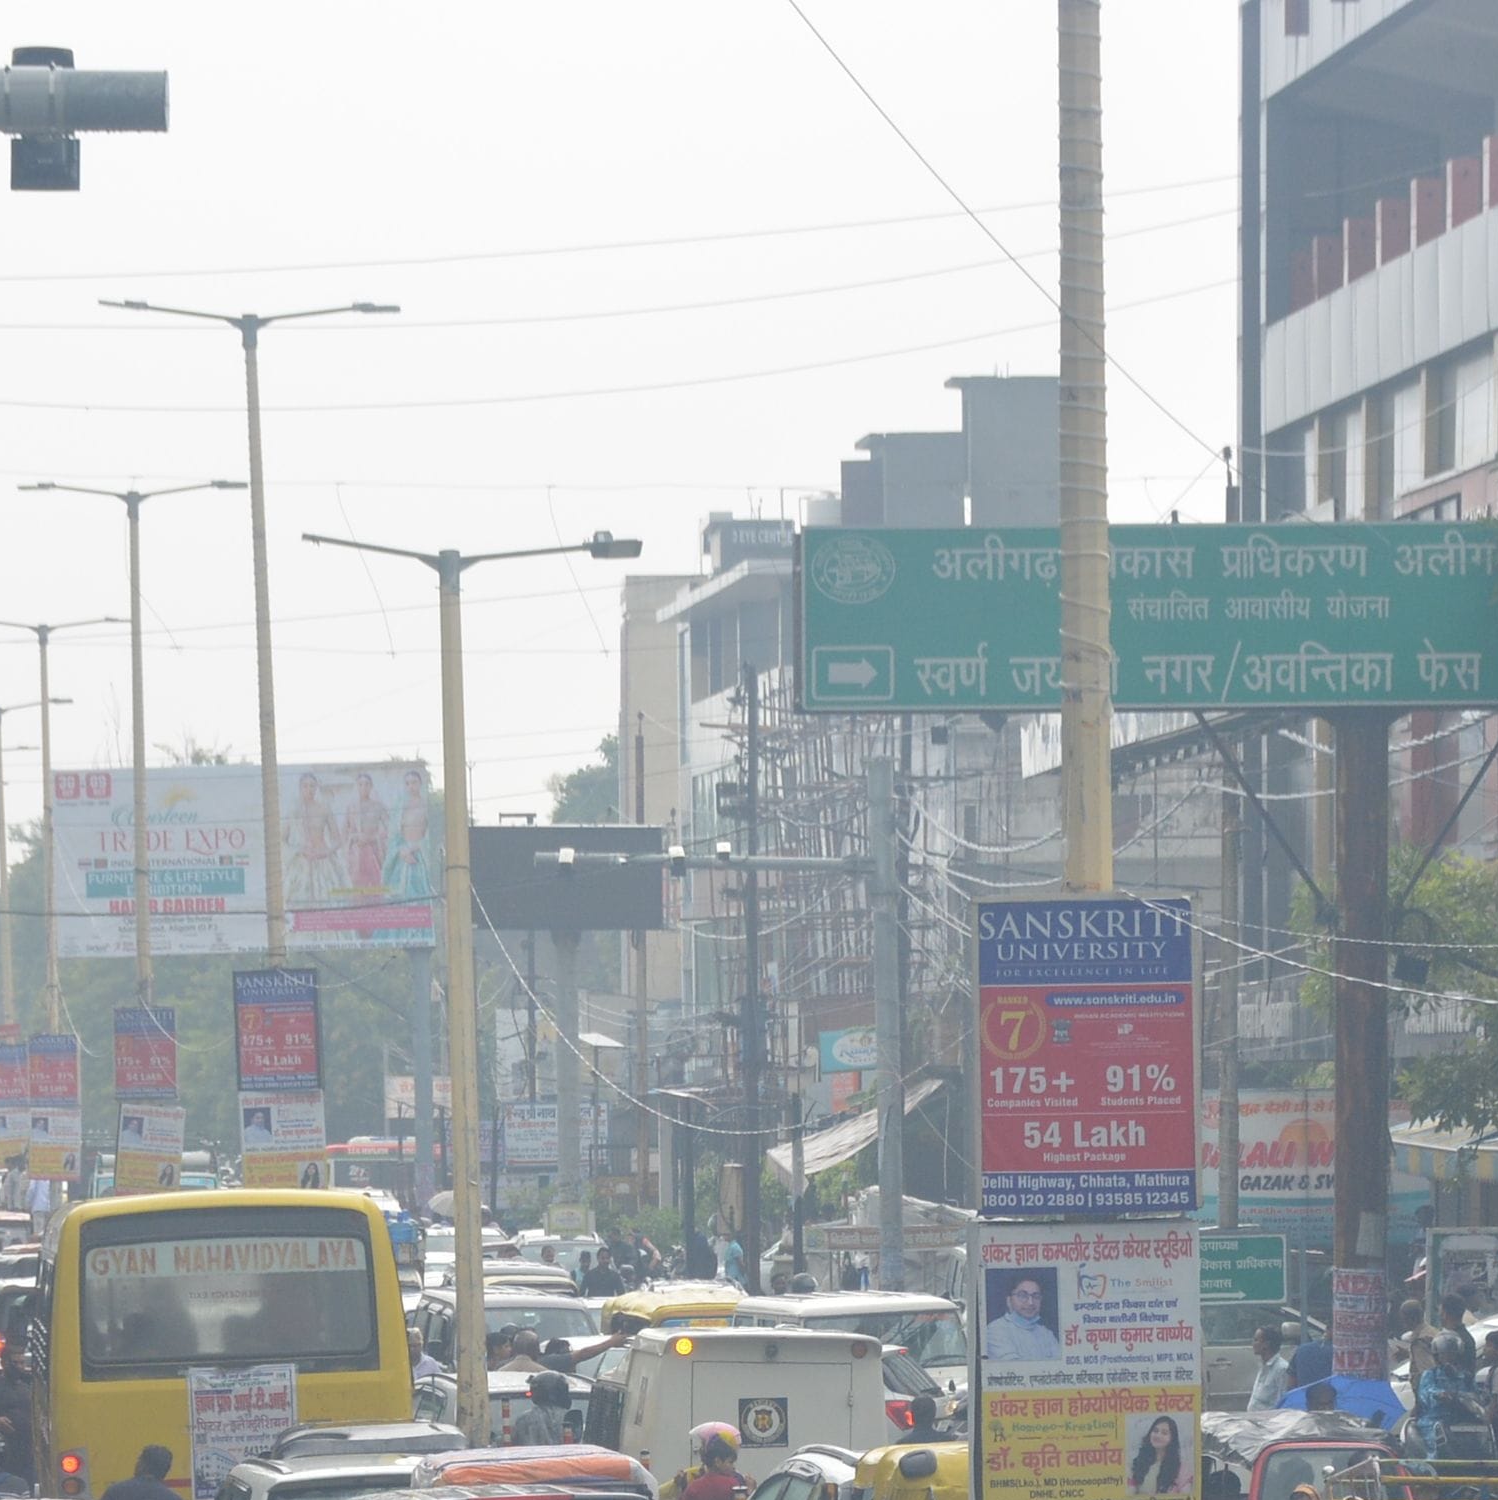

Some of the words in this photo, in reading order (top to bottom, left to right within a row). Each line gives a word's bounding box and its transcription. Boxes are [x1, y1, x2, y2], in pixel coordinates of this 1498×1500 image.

[1221, 533, 1368, 580] प्राधिकरण
[1127, 590, 1210, 621] संचालित
[1224, 591, 1311, 620] आवासीय
[1326, 591, 1390, 620] योजना
[915, 641, 988, 697] स्वर्ण
[1416, 637, 1482, 692] फेस
[185, 828, 246, 854] EXPO
[979, 909, 1191, 941] SANSKRITI
[996, 941, 1168, 962] UNIVERSITY
[1053, 993, 1177, 1006] www.sanskriti.edu.in
[990, 1066, 1075, 1094] 175+
[1106, 1064, 1177, 1092] 91%
[987, 1098, 1041, 1109] Companies
[1045, 1096, 1078, 1107] Visited
[1101, 1096, 1144, 1106] Students
[1148, 1094, 1182, 1105] Placed
[1024, 1122, 1062, 1149] 54
[1074, 1120, 1146, 1147] Lakh
[1043, 1152, 1081, 1164] Highest
[1084, 1151, 1127, 1163] Package
[982, 1176, 1015, 1189] Delhi
[1018, 1175, 1076, 1191] Highway,
[1080, 1174, 1130, 1190] Chhata,
[1134, 1173, 1190, 1188] Mathura
[1240, 1175, 1295, 1191] GAZAK
[982, 1194, 1018, 1207] 1800
[1021, 1194, 1044, 1206] 120
[1047, 1193, 1085, 1206] 2880
[1096, 1192, 1143, 1205] 93585
[1147, 1191, 1190, 1204] 12345
[90, 1246, 157, 1277] GYAN
[173, 1238, 358, 1272] MAHAVIDYALAYA
[982, 1237, 1012, 1263] शंकर
[1014, 1243, 1039, 1265] ज्ञान
[1235, 1255, 1283, 1270] प्राधिकरण
[1110, 1278, 1131, 1287] The
[1065, 1324, 1082, 1346] डॉ.
[1085, 1327, 1117, 1351] कृष्णा
[1120, 1327, 1154, 1352] कुमार
[990, 1393, 1028, 1418] शंकर
[1032, 1397, 1063, 1419] ज्ञान
[1068, 1388, 1150, 1417] होम्योपैथिक
[1154, 1388, 1196, 1412] सेन्टर
[988, 1446, 1015, 1472] डॉ.
[1021, 1443, 1061, 1476] कृति
[1044, 1478, 1057, 1487] MD
